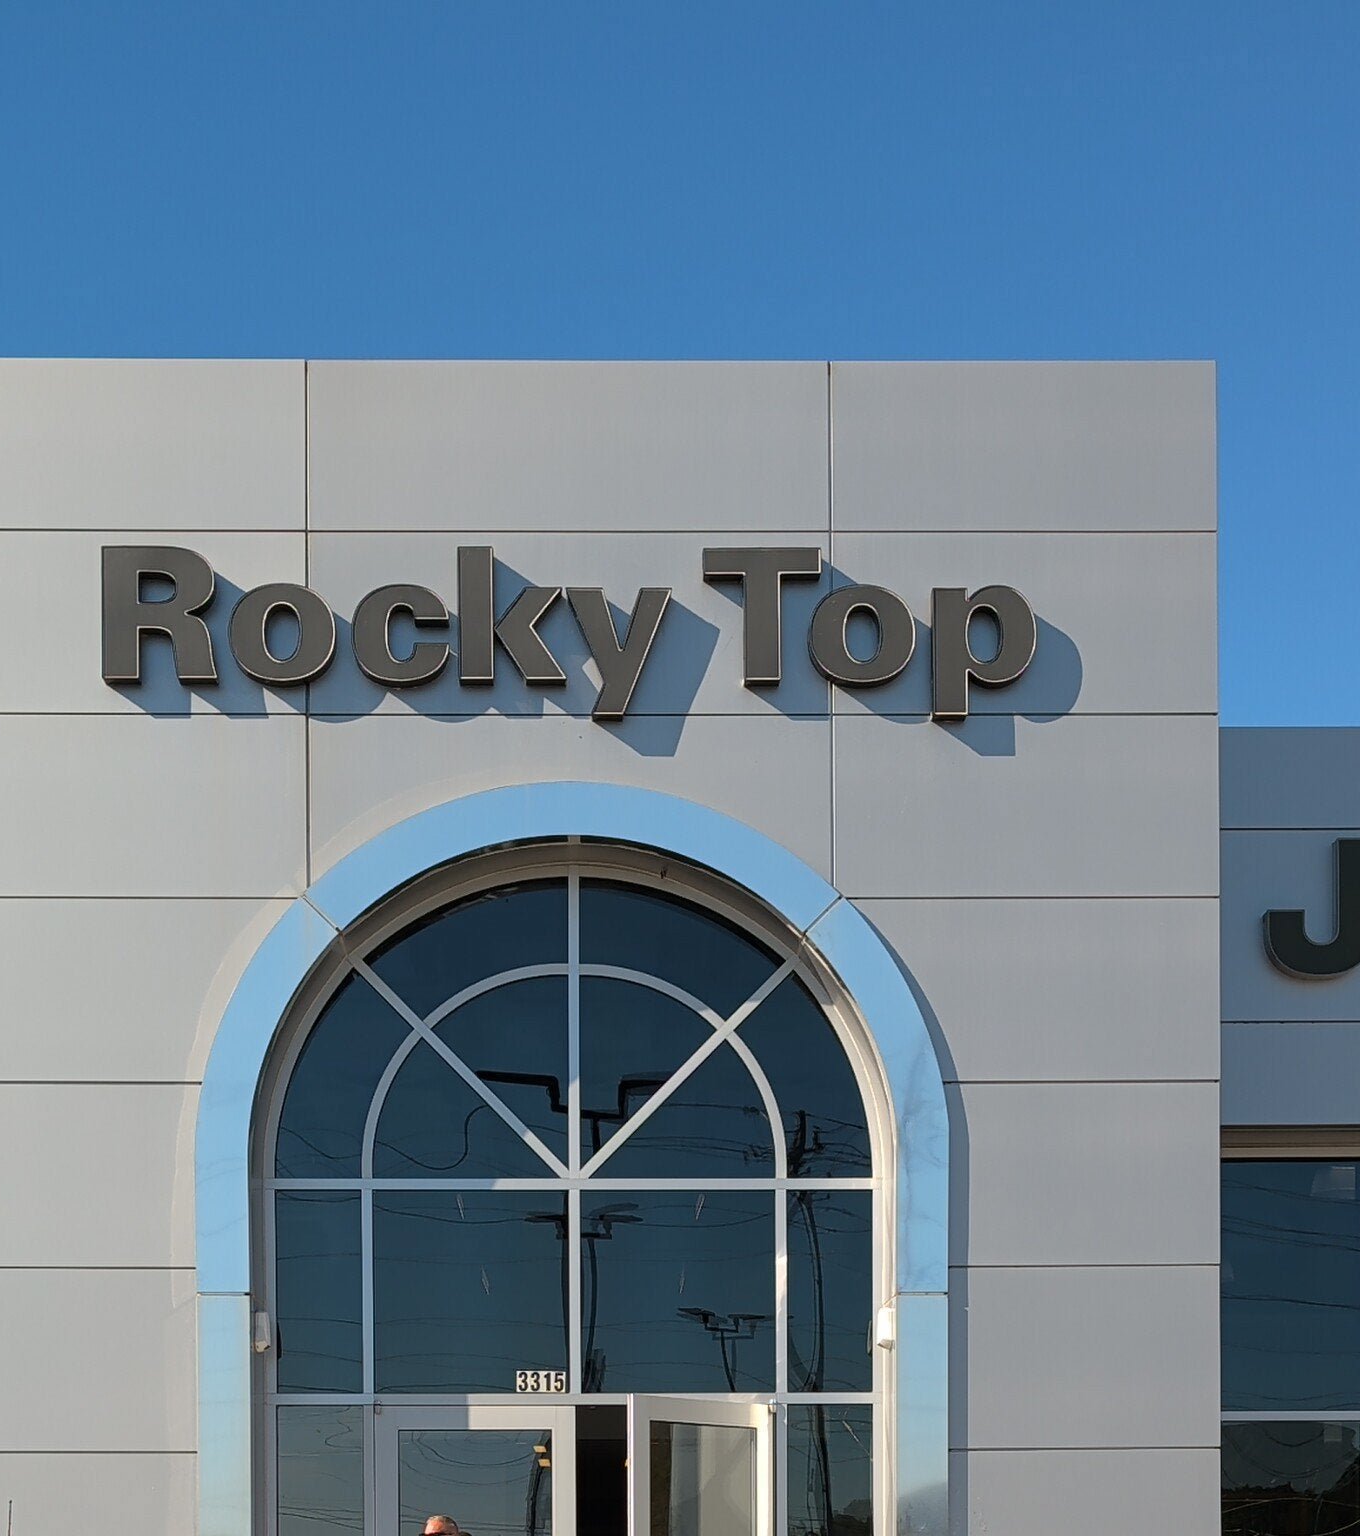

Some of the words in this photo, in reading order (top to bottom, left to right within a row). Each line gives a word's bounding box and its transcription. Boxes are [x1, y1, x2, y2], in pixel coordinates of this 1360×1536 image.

[101, 545, 672, 722] Rocky
[701, 546, 1037, 722] Top
[518, 1371, 564, 1392] 3315
